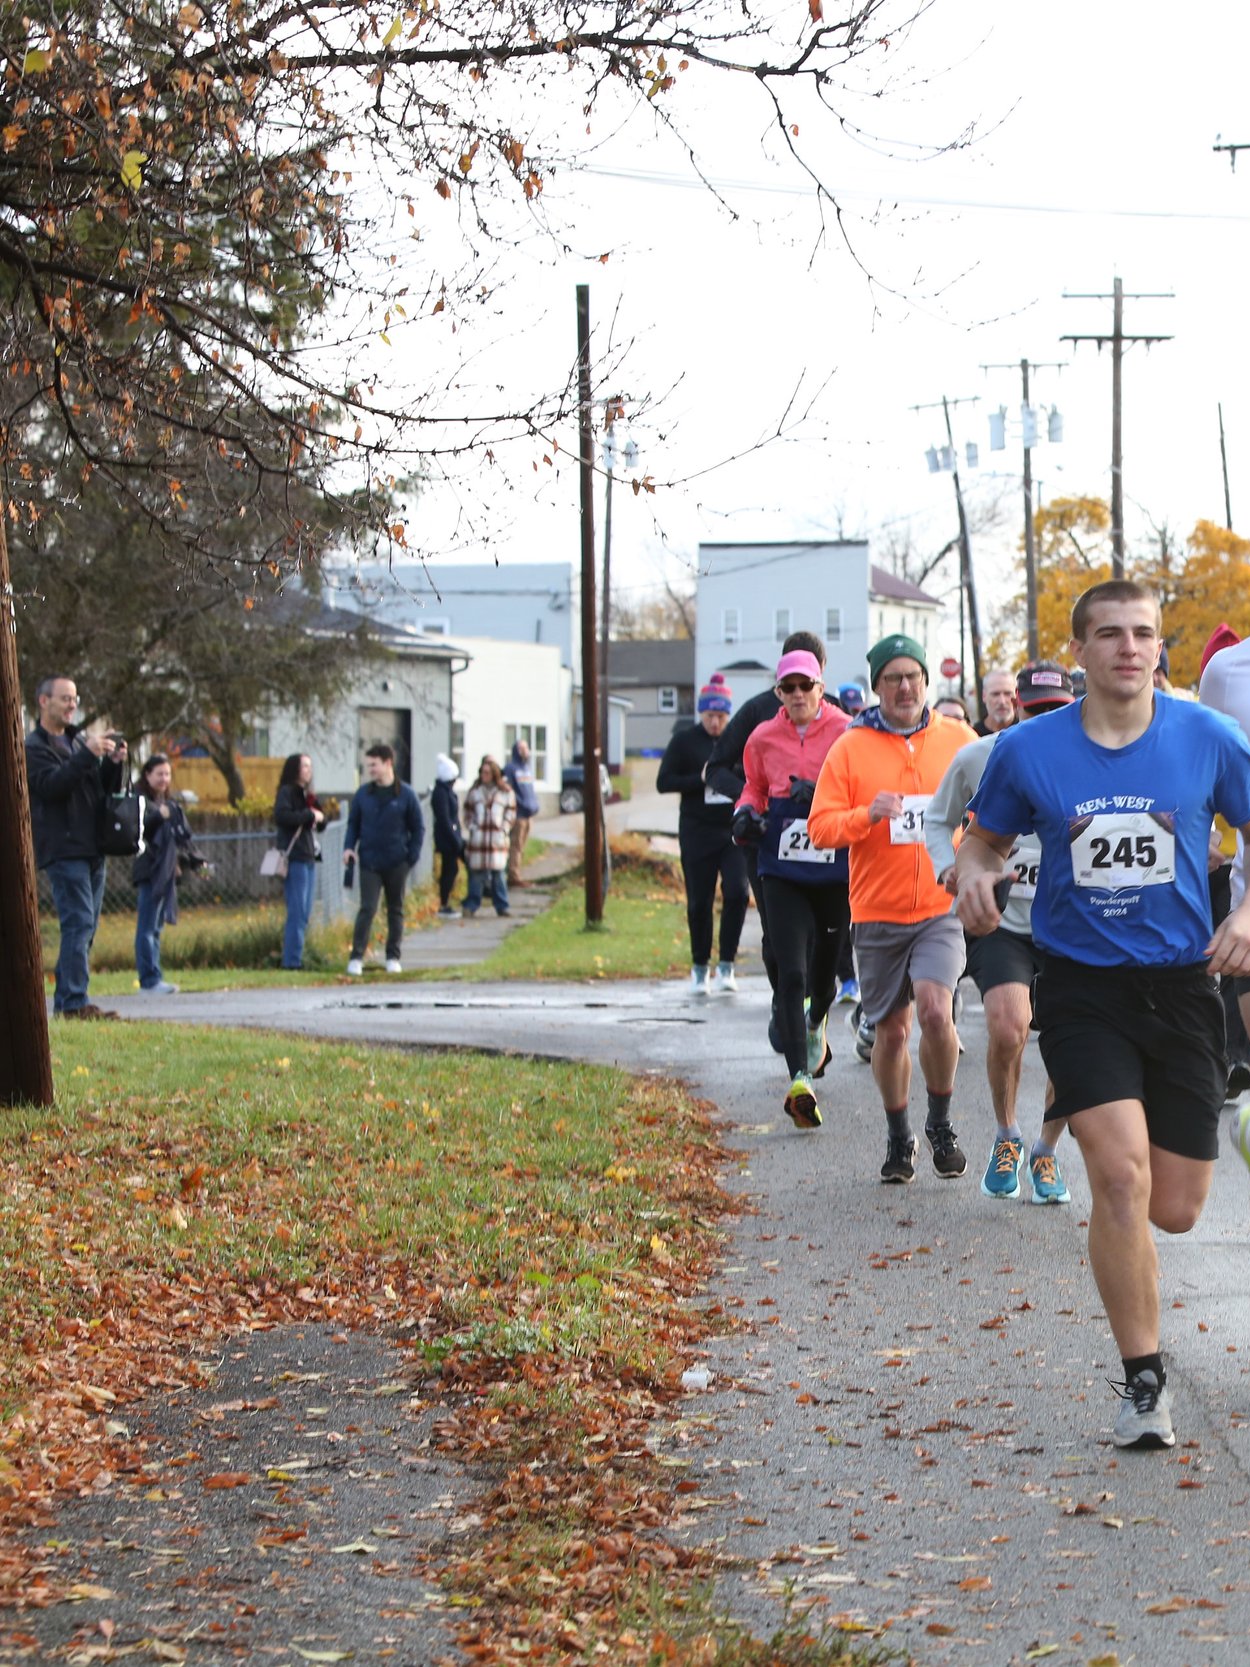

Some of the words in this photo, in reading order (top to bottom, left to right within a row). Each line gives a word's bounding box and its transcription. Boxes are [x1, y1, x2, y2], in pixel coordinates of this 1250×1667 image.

[1075, 795, 1155, 816] KEN-WEST
[789, 832, 824, 850] 27
[1090, 836, 1157, 868] 245
[1103, 907, 1128, 917] 2024
